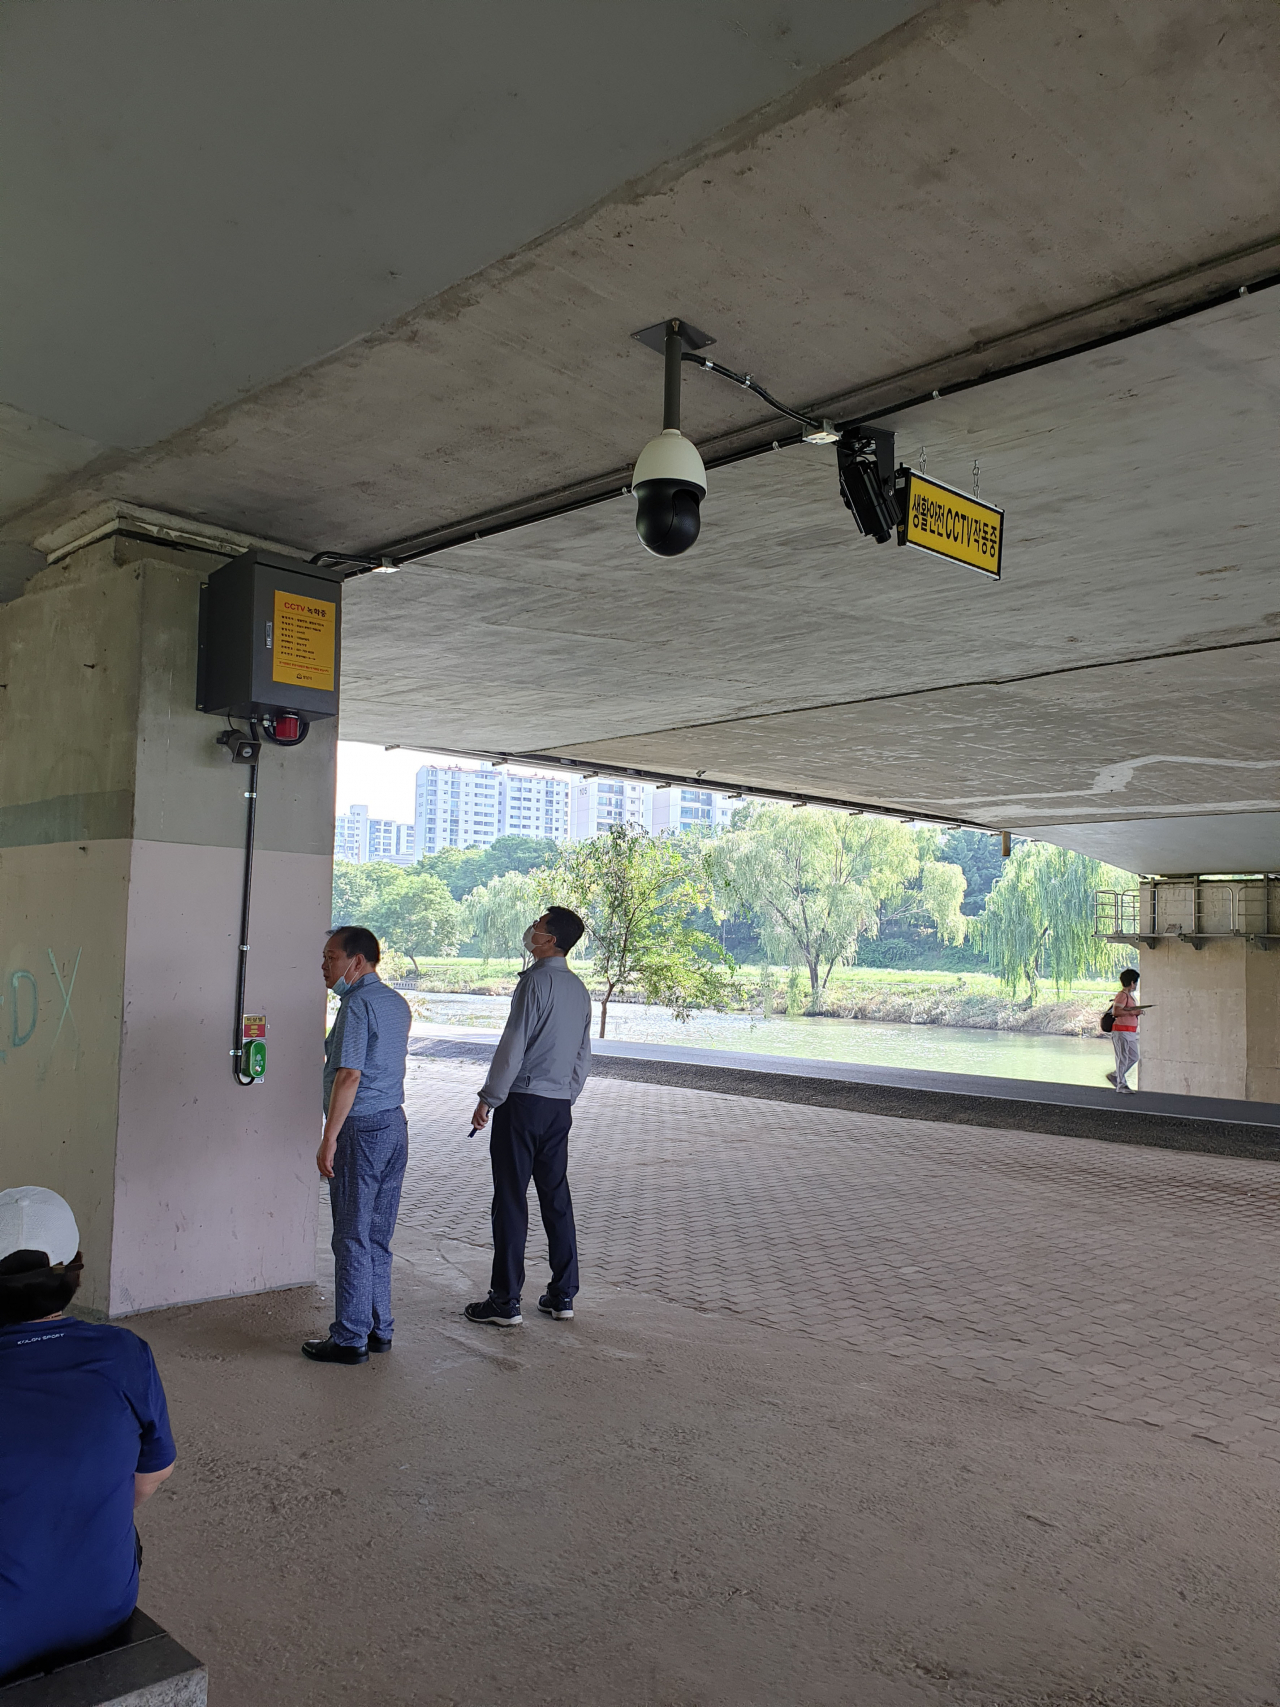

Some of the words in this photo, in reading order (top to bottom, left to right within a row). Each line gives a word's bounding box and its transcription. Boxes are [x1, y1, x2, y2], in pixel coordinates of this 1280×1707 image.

[284, 602, 306, 612] CCTV
[307, 607, 327, 618] 녹화중
[42, 1333, 65, 1341] SPORT
